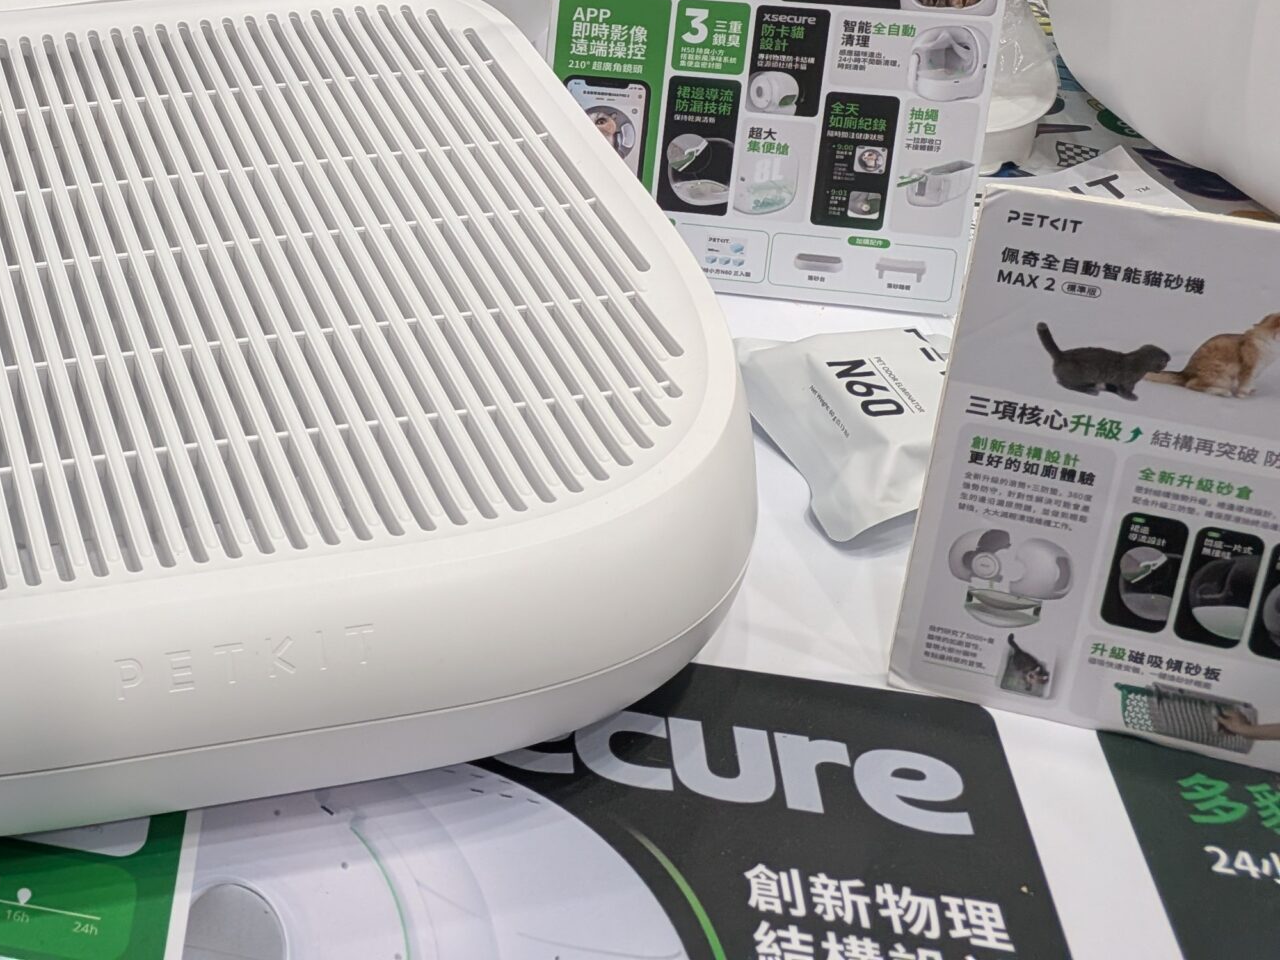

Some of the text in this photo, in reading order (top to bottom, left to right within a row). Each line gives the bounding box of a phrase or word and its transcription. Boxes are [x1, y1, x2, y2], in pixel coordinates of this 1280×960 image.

[572, 7, 612, 22] APP
[763, 12, 817, 25] xsecure
[572, 21, 648, 43] 即時影像
[681, 7, 709, 44] 3
[713, 20, 744, 35] 三重
[761, 24, 806, 39] 防卡貓
[842, 19, 917, 38] 智能全自動
[570, 39, 647, 60] 遠端操控
[711, 33, 741, 48] 鎖臭
[759, 38, 789, 52] 設計
[841, 33, 871, 48] 清理
[591, 61, 644, 74] 超廣角鏡頭
[676, 85, 734, 103] 裙邊導流
[675, 98, 733, 116] 防漏技術
[831, 101, 860, 116] 全天
[910, 106, 940, 122] 抽繩
[747, 126, 777, 141] 超大
[828, 115, 887, 133] 如廁紀錄
[907, 121, 937, 136] 打包
[1007, 210, 1083, 234] PETKIT
[997, 269, 1056, 292] MAX 2
[826, 358, 905, 418] N60
[872, 354, 925, 415] PET ODOR ELIMINATOR
[965, 394, 1123, 442] 三項核心升級
[970, 435, 1080, 468] 創新結構設計
[1150, 429, 1260, 465] 結構再突破
[968, 450, 1096, 487] 更好的如廁體驗
[1138, 467, 1253, 501] 全新升級砂倉
[114, 623, 374, 701] PETKIT
[1090, 642, 1222, 682] 升級磁吸傾砂板
[743, 863, 1016, 952] 創新物理
[5, 909, 31, 924] 16h
[73, 921, 99, 936] 24h
